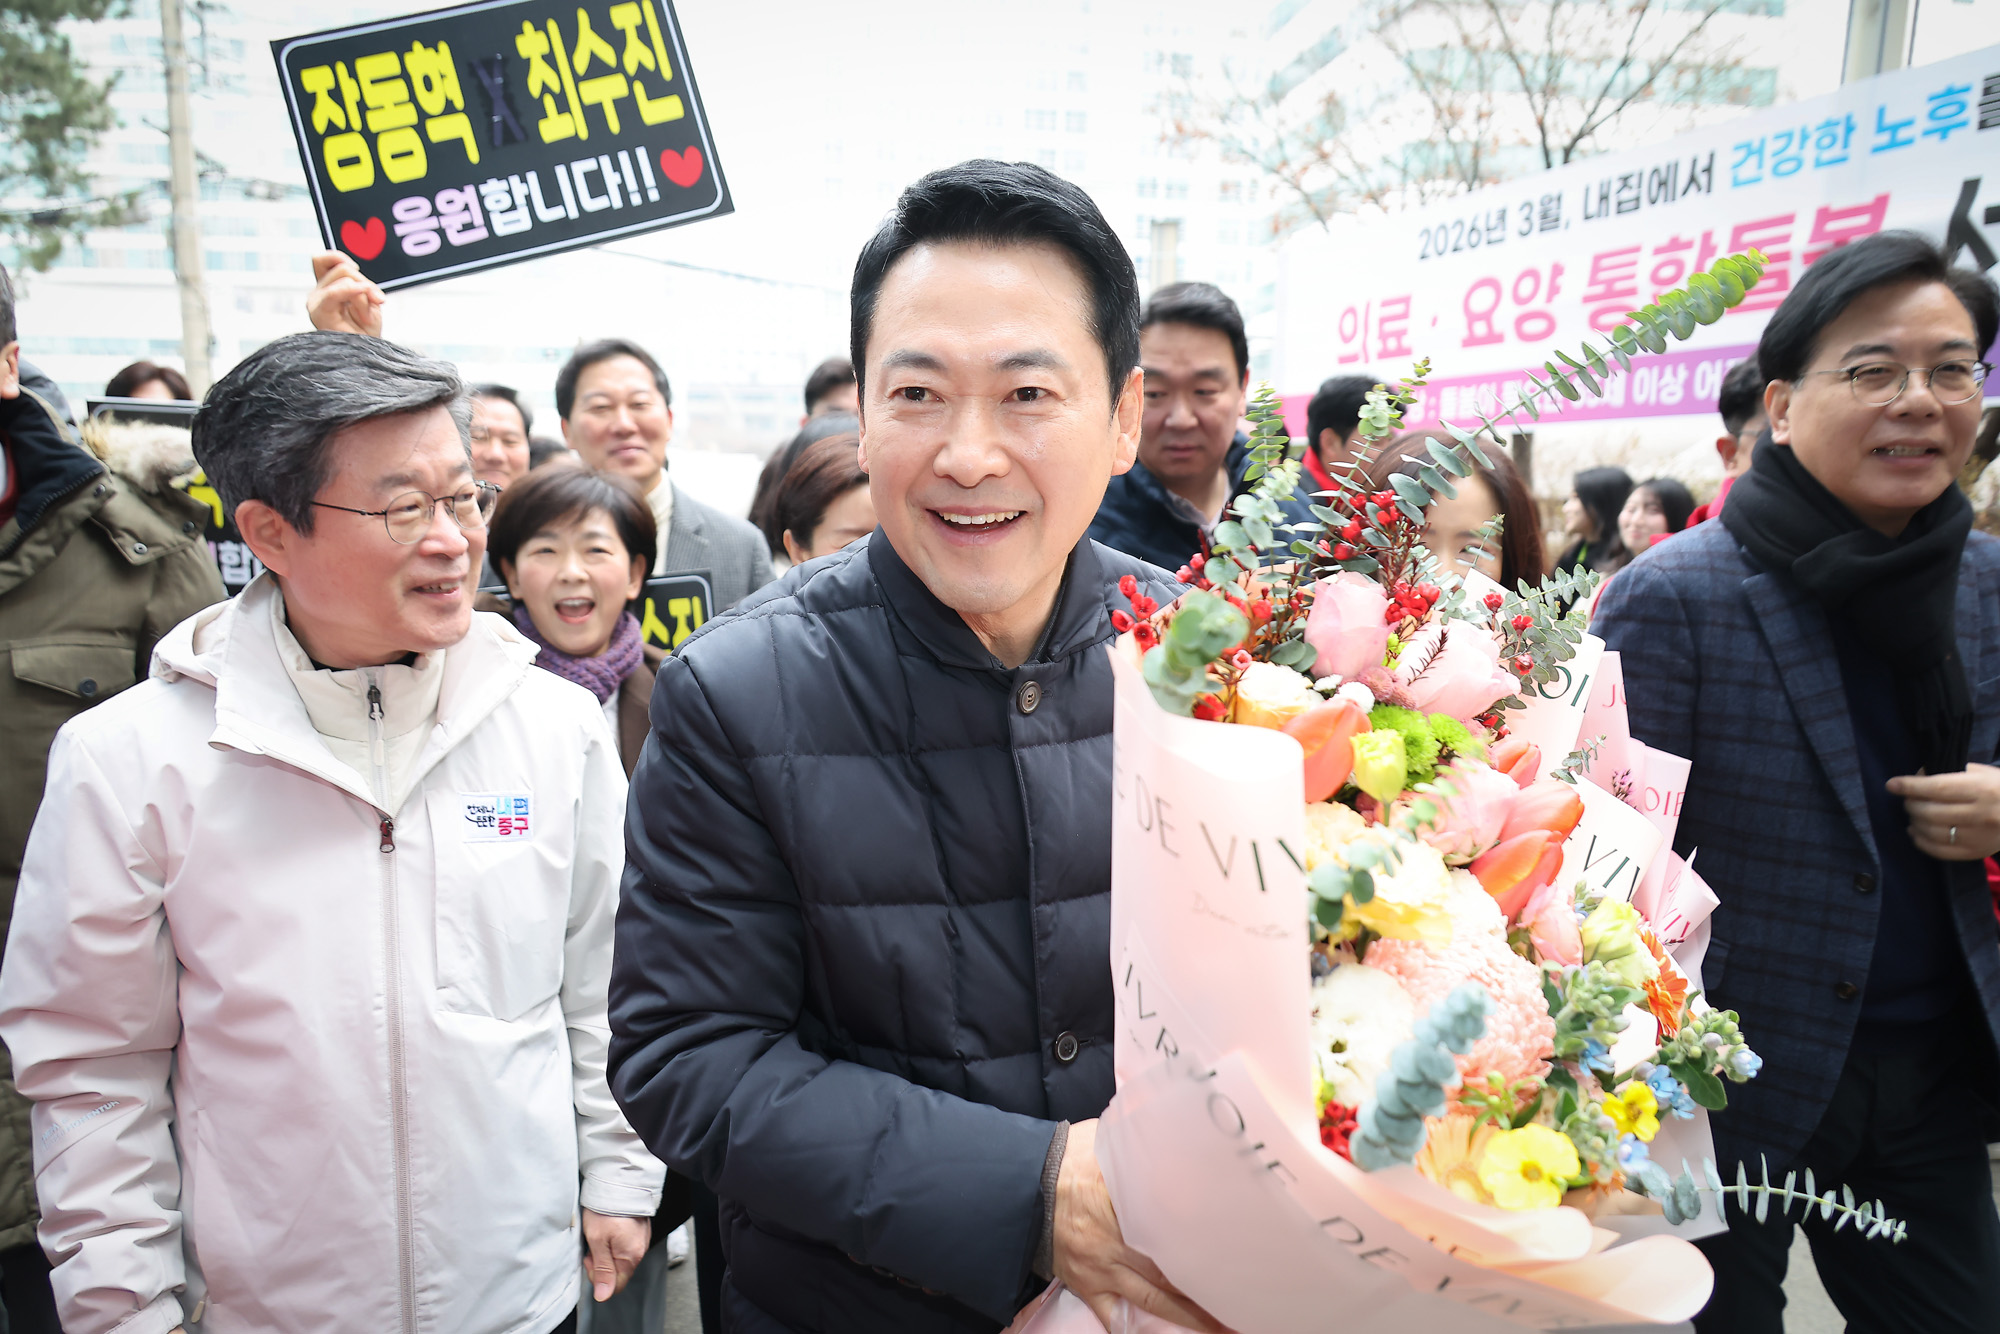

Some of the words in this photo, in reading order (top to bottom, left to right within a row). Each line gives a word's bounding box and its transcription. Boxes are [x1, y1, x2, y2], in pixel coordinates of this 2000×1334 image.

[301, 40, 480, 193] 장동혁
[515, 0, 685, 144] 최수진
[391, 145, 661, 257] 응원합니다!!
[1418, 206, 1508, 261] 2026년
[1517, 191, 1570, 238] 3월,
[1583, 150, 1716, 221] 내집에서
[1731, 112, 1856, 189] 건강한
[1338, 293, 1412, 364] 의료
[1461, 260, 1566, 350] 요양
[1632, 362, 1690, 406] 이상
